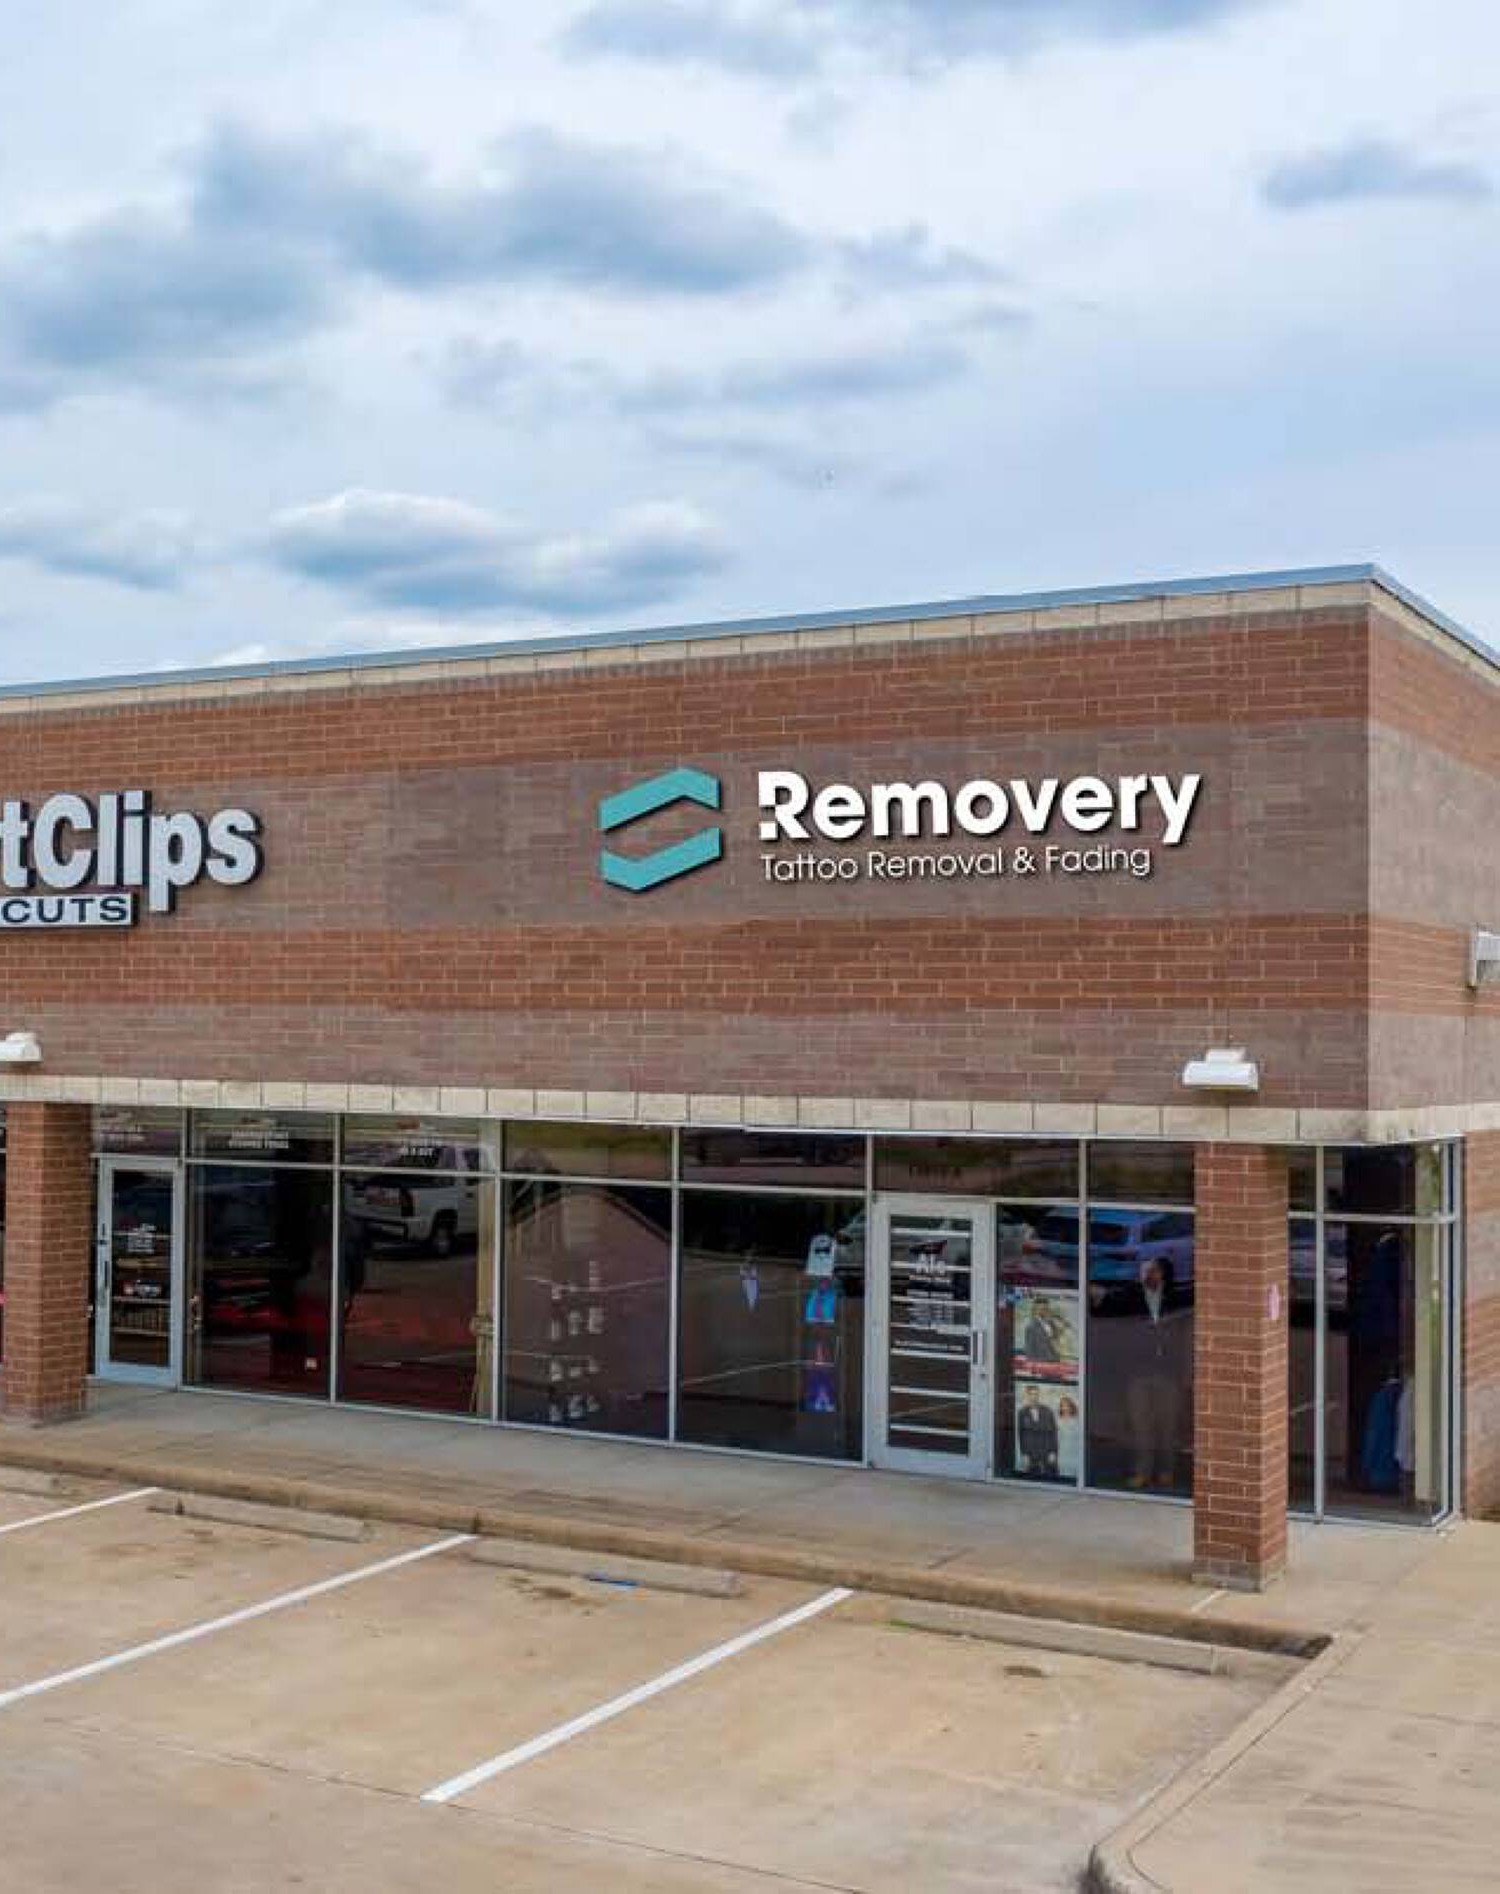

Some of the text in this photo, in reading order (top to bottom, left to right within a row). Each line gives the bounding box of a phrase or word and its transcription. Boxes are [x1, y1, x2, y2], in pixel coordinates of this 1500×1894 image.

[758, 770, 1201, 845] Removery
[761, 844, 1151, 881] Tattoo Removal & Fading
